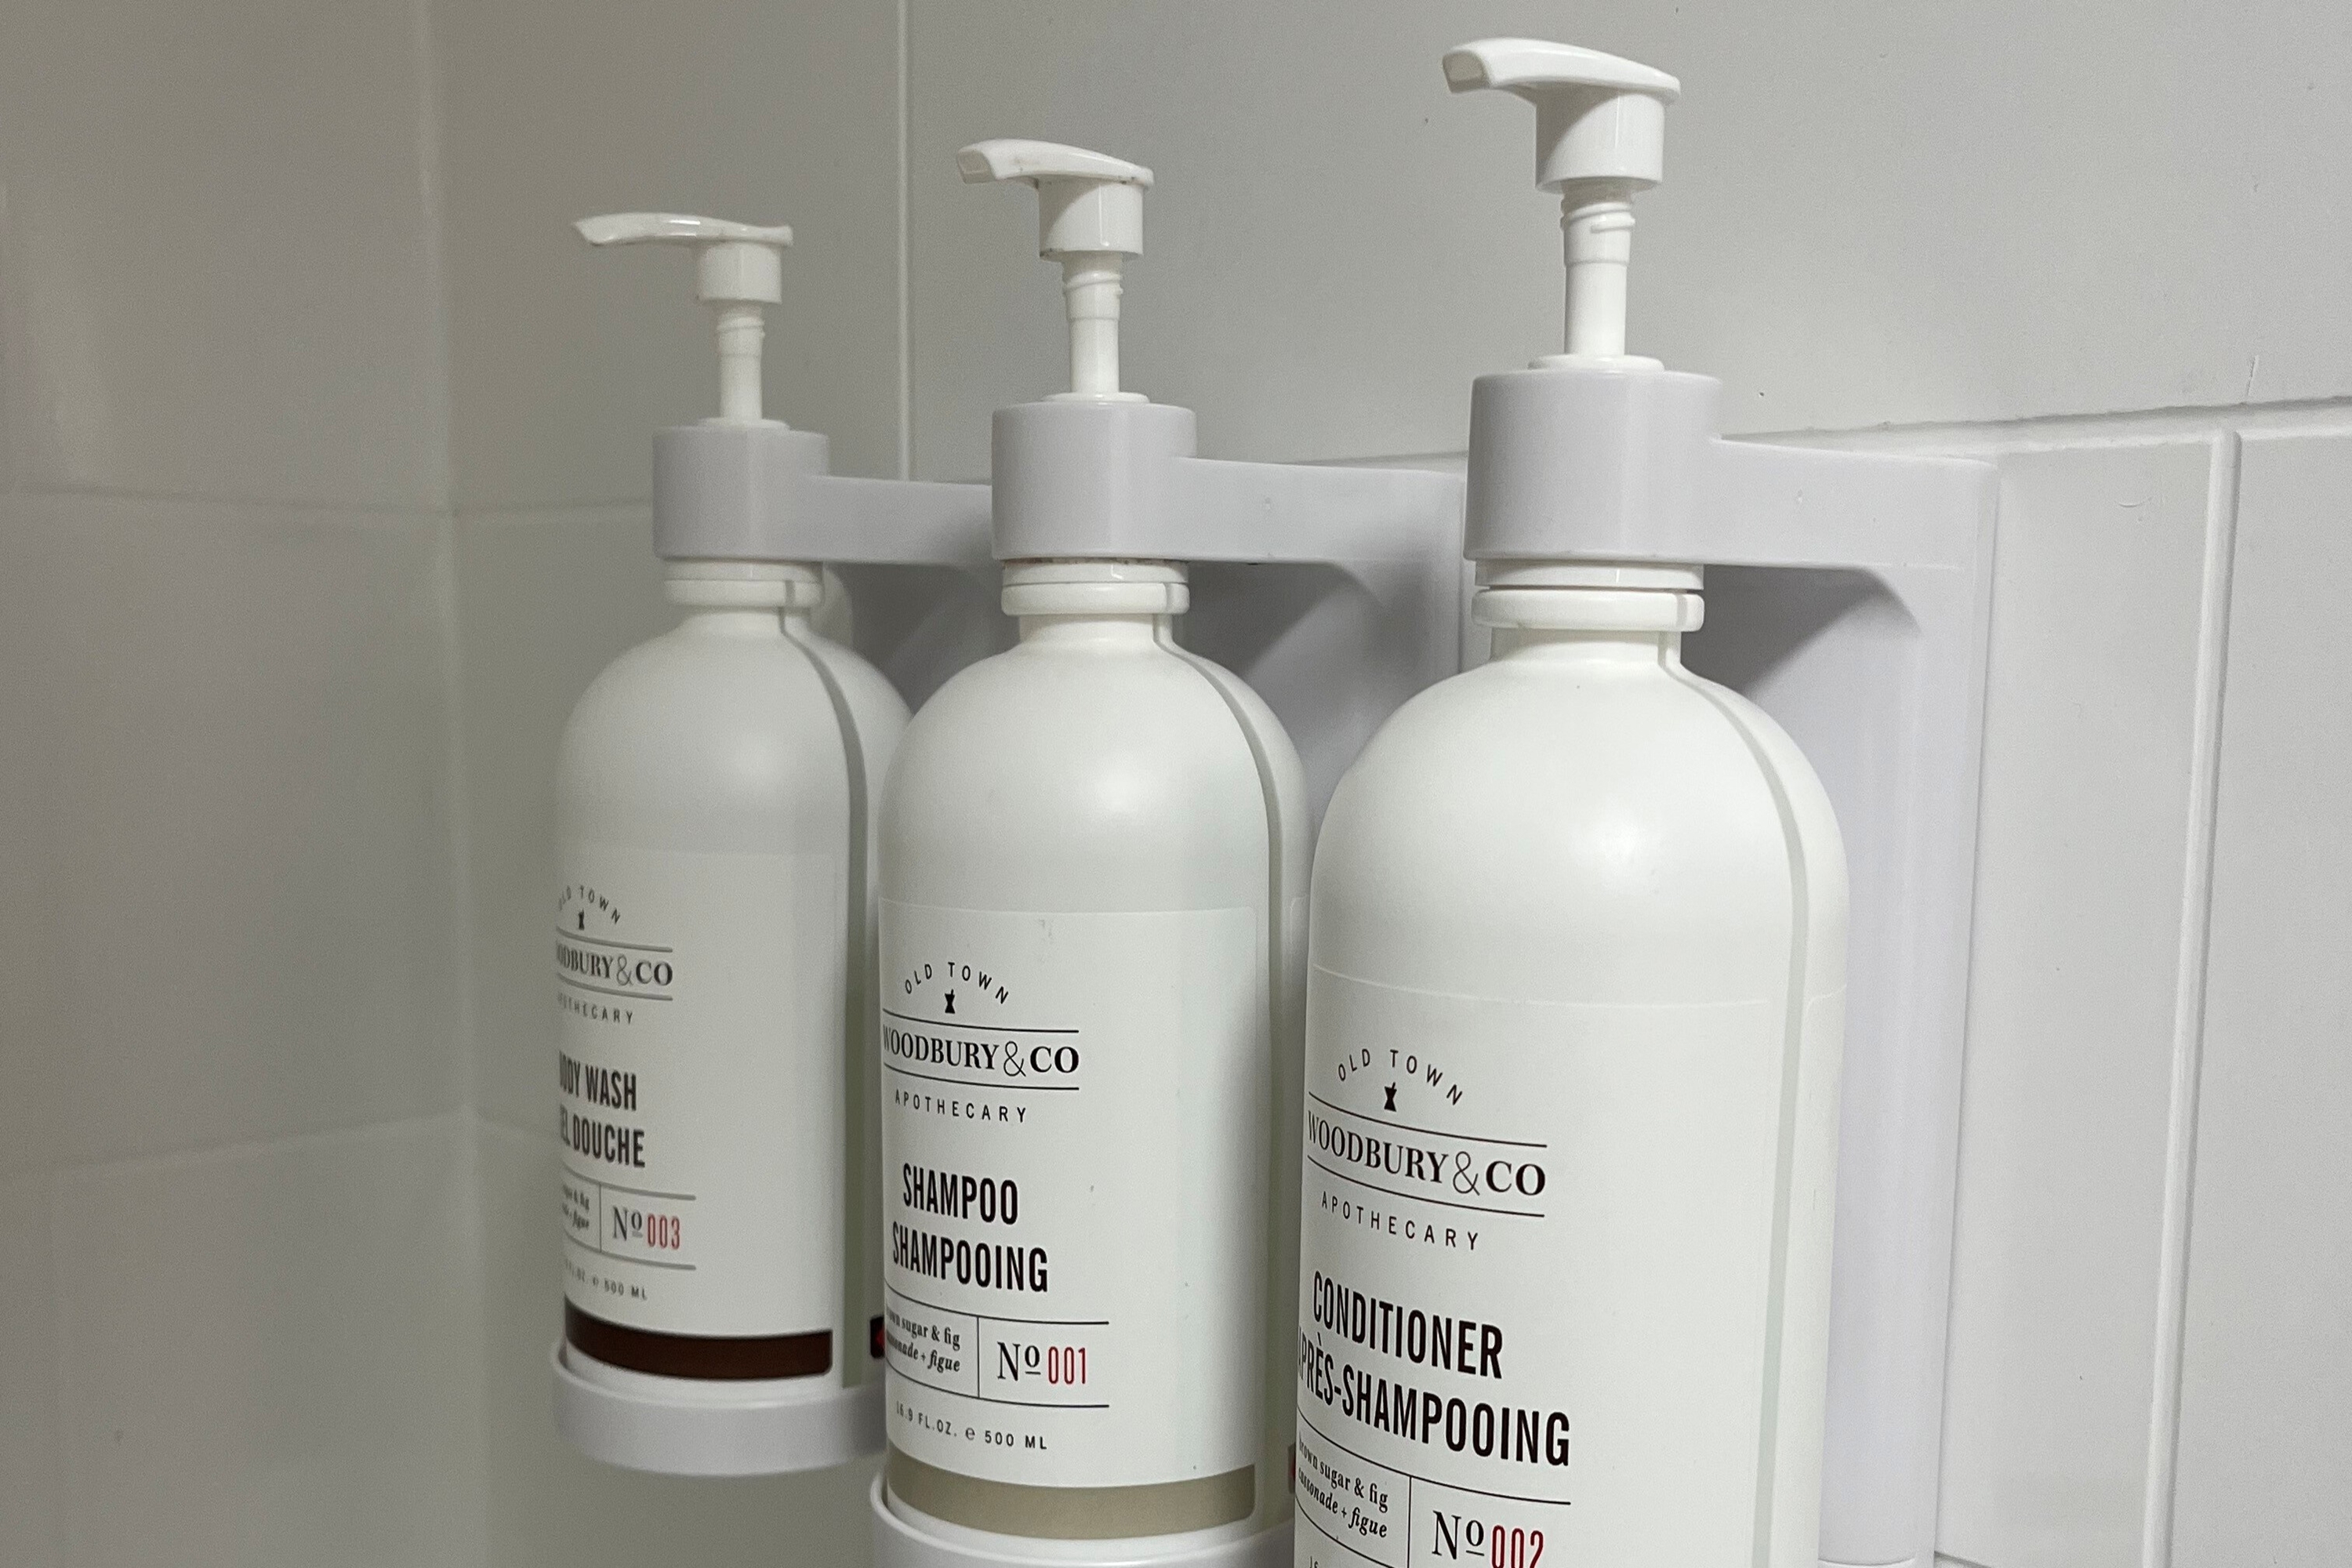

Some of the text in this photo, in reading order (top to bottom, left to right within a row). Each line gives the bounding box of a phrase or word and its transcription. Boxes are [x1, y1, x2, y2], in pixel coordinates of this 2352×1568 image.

[580, 885, 620, 924] TOWN
[906, 962, 1009, 1004] OLD TOWN
[586, 1064, 637, 1111] WASH
[1338, 1049, 1463, 1105] OLD TOWN
[895, 1089, 1026, 1123] APOTHECARY
[573, 1114, 645, 1167] DOUCHE
[903, 1163, 1018, 1225] SHAMPOO
[648, 1213, 681, 1250] 003
[1322, 1191, 1479, 1250] APOTHECARY
[892, 1221, 1048, 1292] SHAMPOOING
[631, 1284, 648, 1301] ML
[902, 1318, 928, 1338] sugar
[931, 1325, 940, 1342] &
[944, 1327, 960, 1351] fig
[1314, 1271, 1503, 1379] CONDITIONER
[927, 1349, 960, 1374] figue
[1048, 1345, 1087, 1385] 001
[985, 1430, 1014, 1447] 500
[1025, 1435, 1047, 1450] ML
[1320, 1461, 1350, 1490] sugar
[1354, 1478, 1364, 1498] &
[1370, 1483, 1388, 1513] fig
[1348, 1507, 1387, 1537] figue
